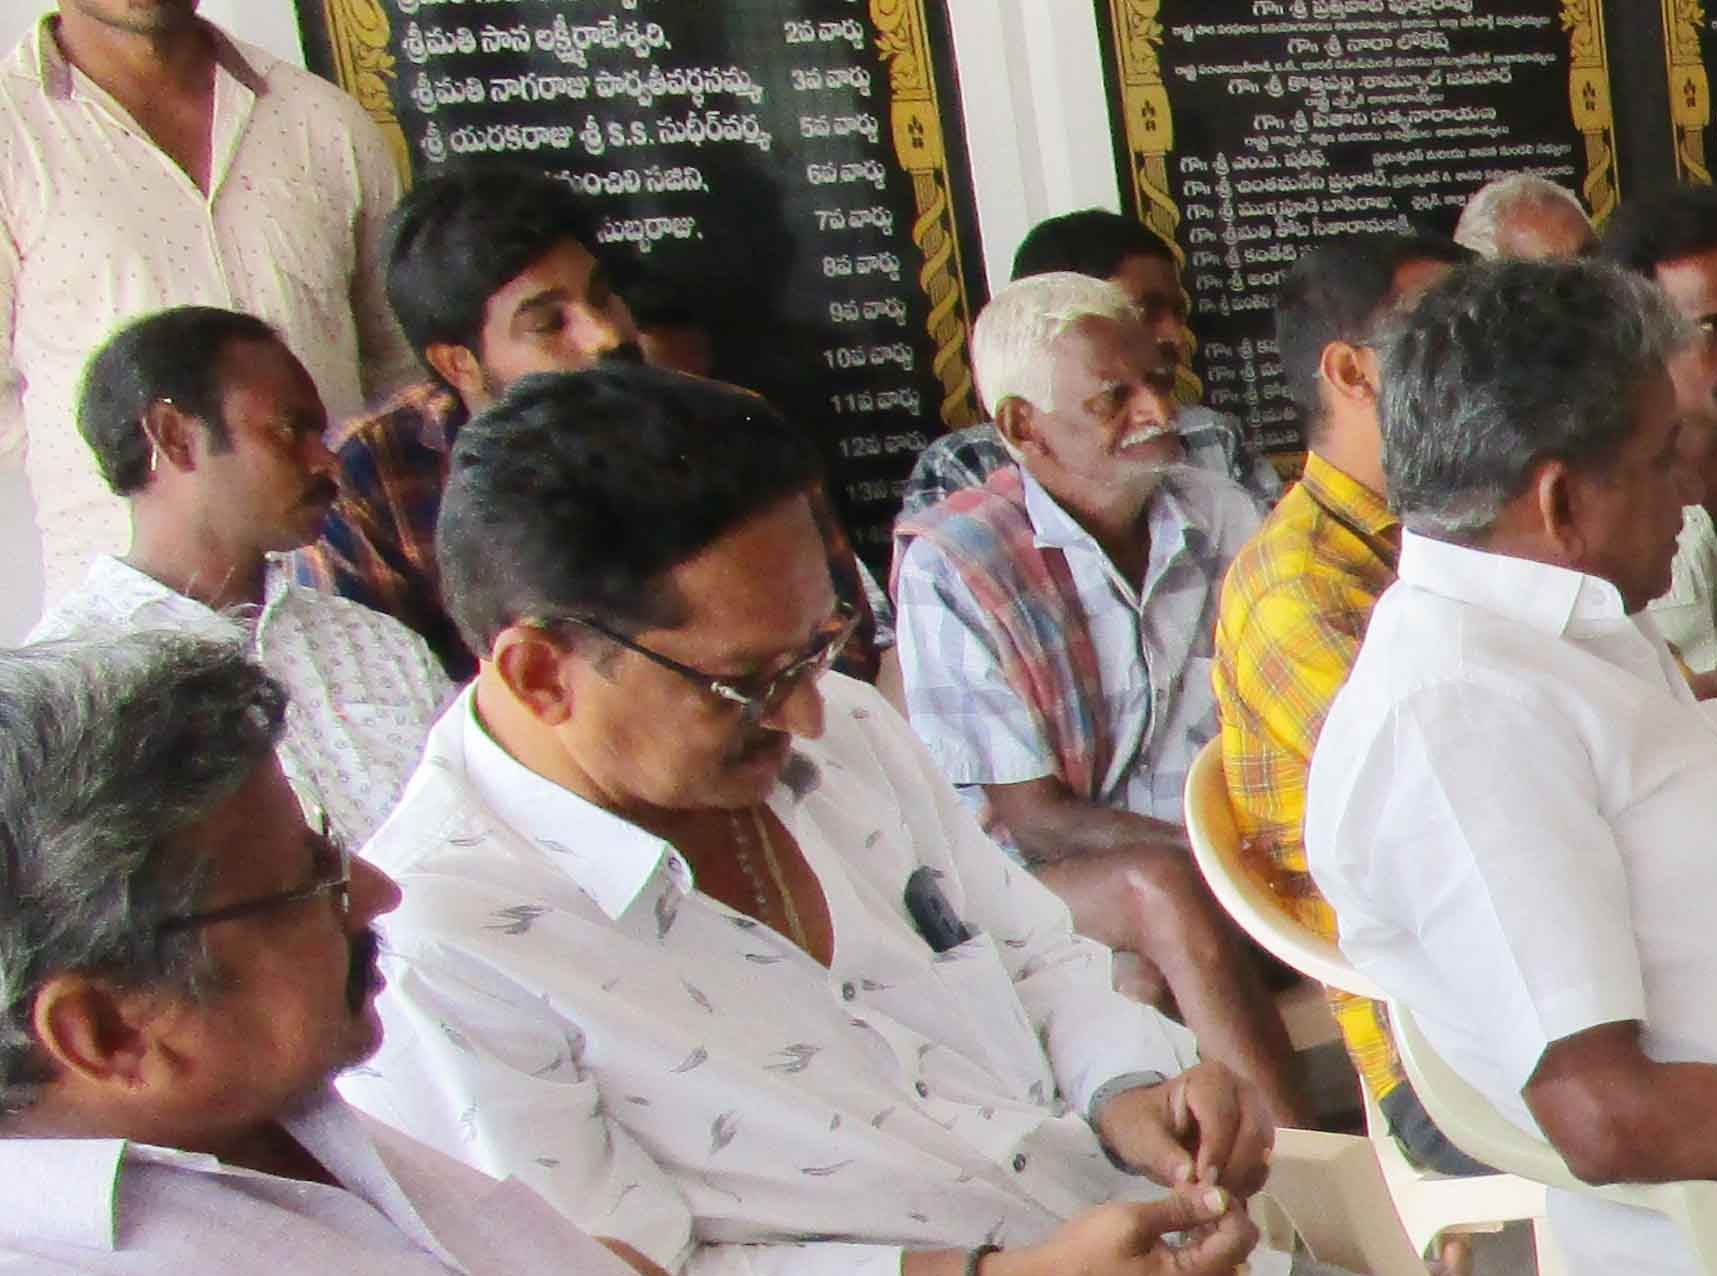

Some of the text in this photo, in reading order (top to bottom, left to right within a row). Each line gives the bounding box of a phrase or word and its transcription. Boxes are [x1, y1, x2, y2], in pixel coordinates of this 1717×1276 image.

[402, 21, 477, 63] శ్రీమతి
[481, 25, 531, 54] సాన
[784, 18, 864, 49] 2వ వార్డు
[411, 71, 485, 113] శ్రీమతి
[490, 74, 590, 103] నాగరాజు
[792, 65, 871, 96] 3వ వార్డు
[420, 120, 447, 162] శ్రీ
[451, 125, 574, 153] యరకరాజు
[580, 115, 606, 154] శ్రీ
[800, 113, 878, 143] 5వ వార్డు
[807, 160, 886, 189] 6వ వార్డు
[815, 206, 893, 236] 7వ వార్డు
[823, 252, 900, 281] 8వ వార్డు
[829, 297, 906, 326] 9వ వార్డు
[824, 342, 913, 371] 10వ వార్డు
[877, 387, 920, 416] వార్డు
